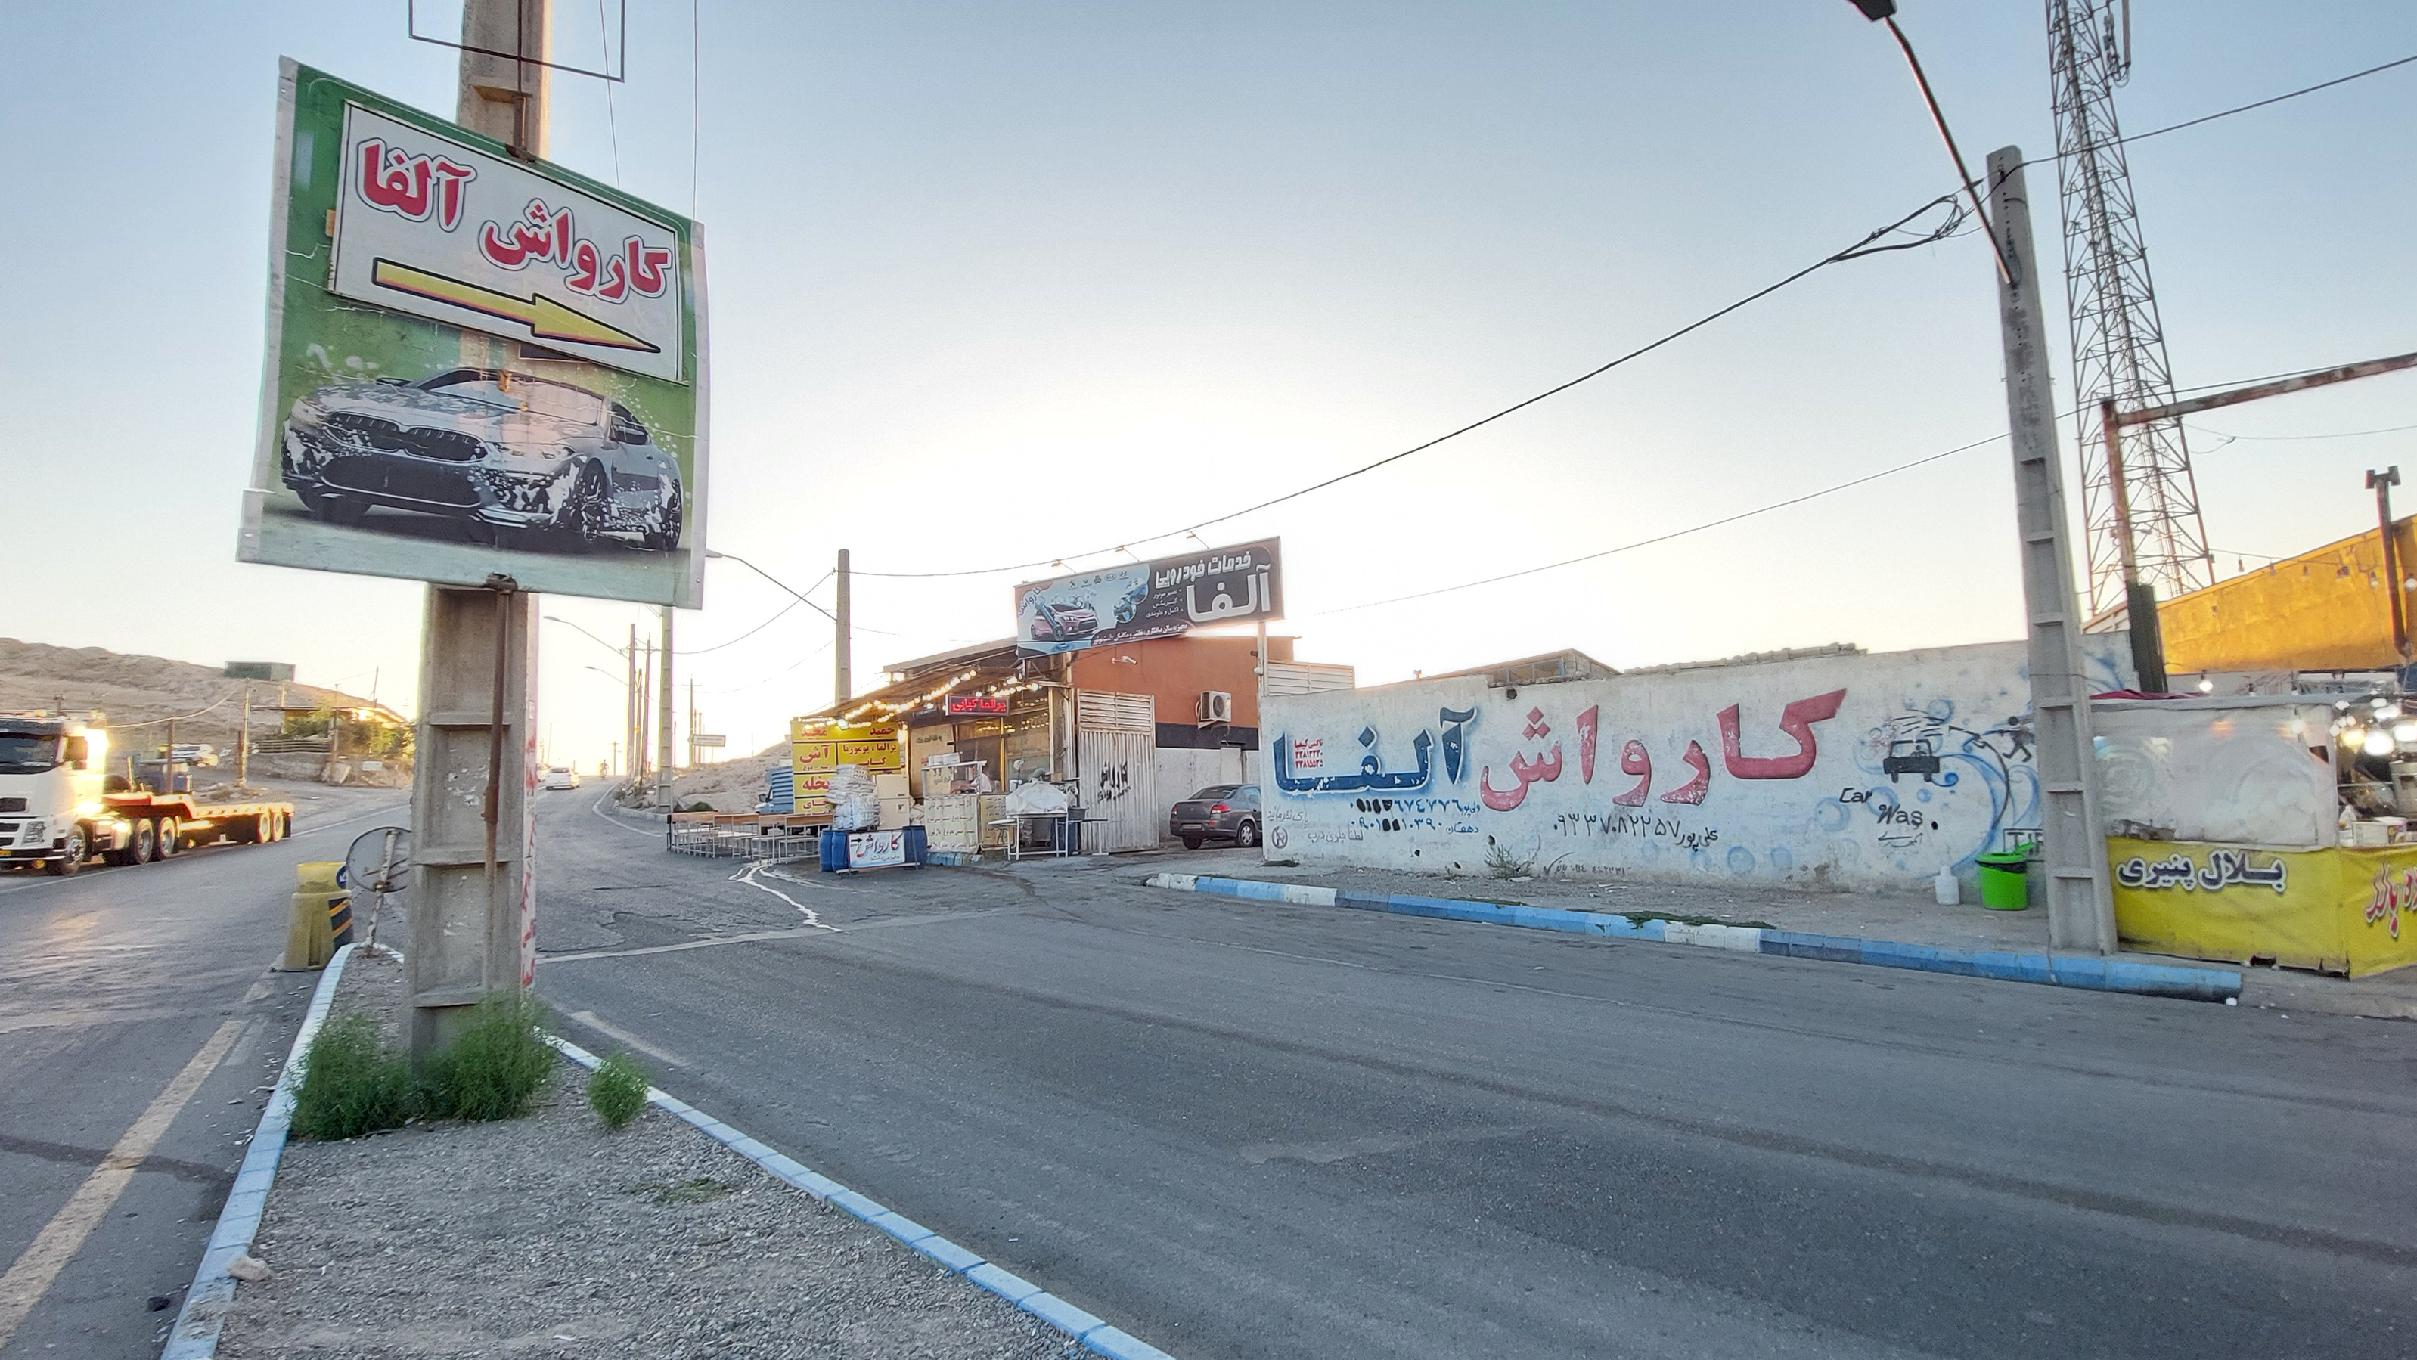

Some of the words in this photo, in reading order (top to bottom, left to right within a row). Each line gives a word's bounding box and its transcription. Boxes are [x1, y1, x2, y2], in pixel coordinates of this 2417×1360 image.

[361, 141, 473, 229] آلفا
[482, 201, 671, 300] کارواش
[1207, 551, 1251, 576] خدمات
[1186, 563, 1272, 622] آلفا
[799, 744, 830, 764] آش
[1273, 706, 1478, 794] آلفا
[1480, 686, 1848, 813] کارواش
[1839, 787, 1873, 804] Car
[857, 832, 903, 858] کارواش
[2118, 854, 2194, 889] پنیری
[2201, 851, 2285, 890] بلال
